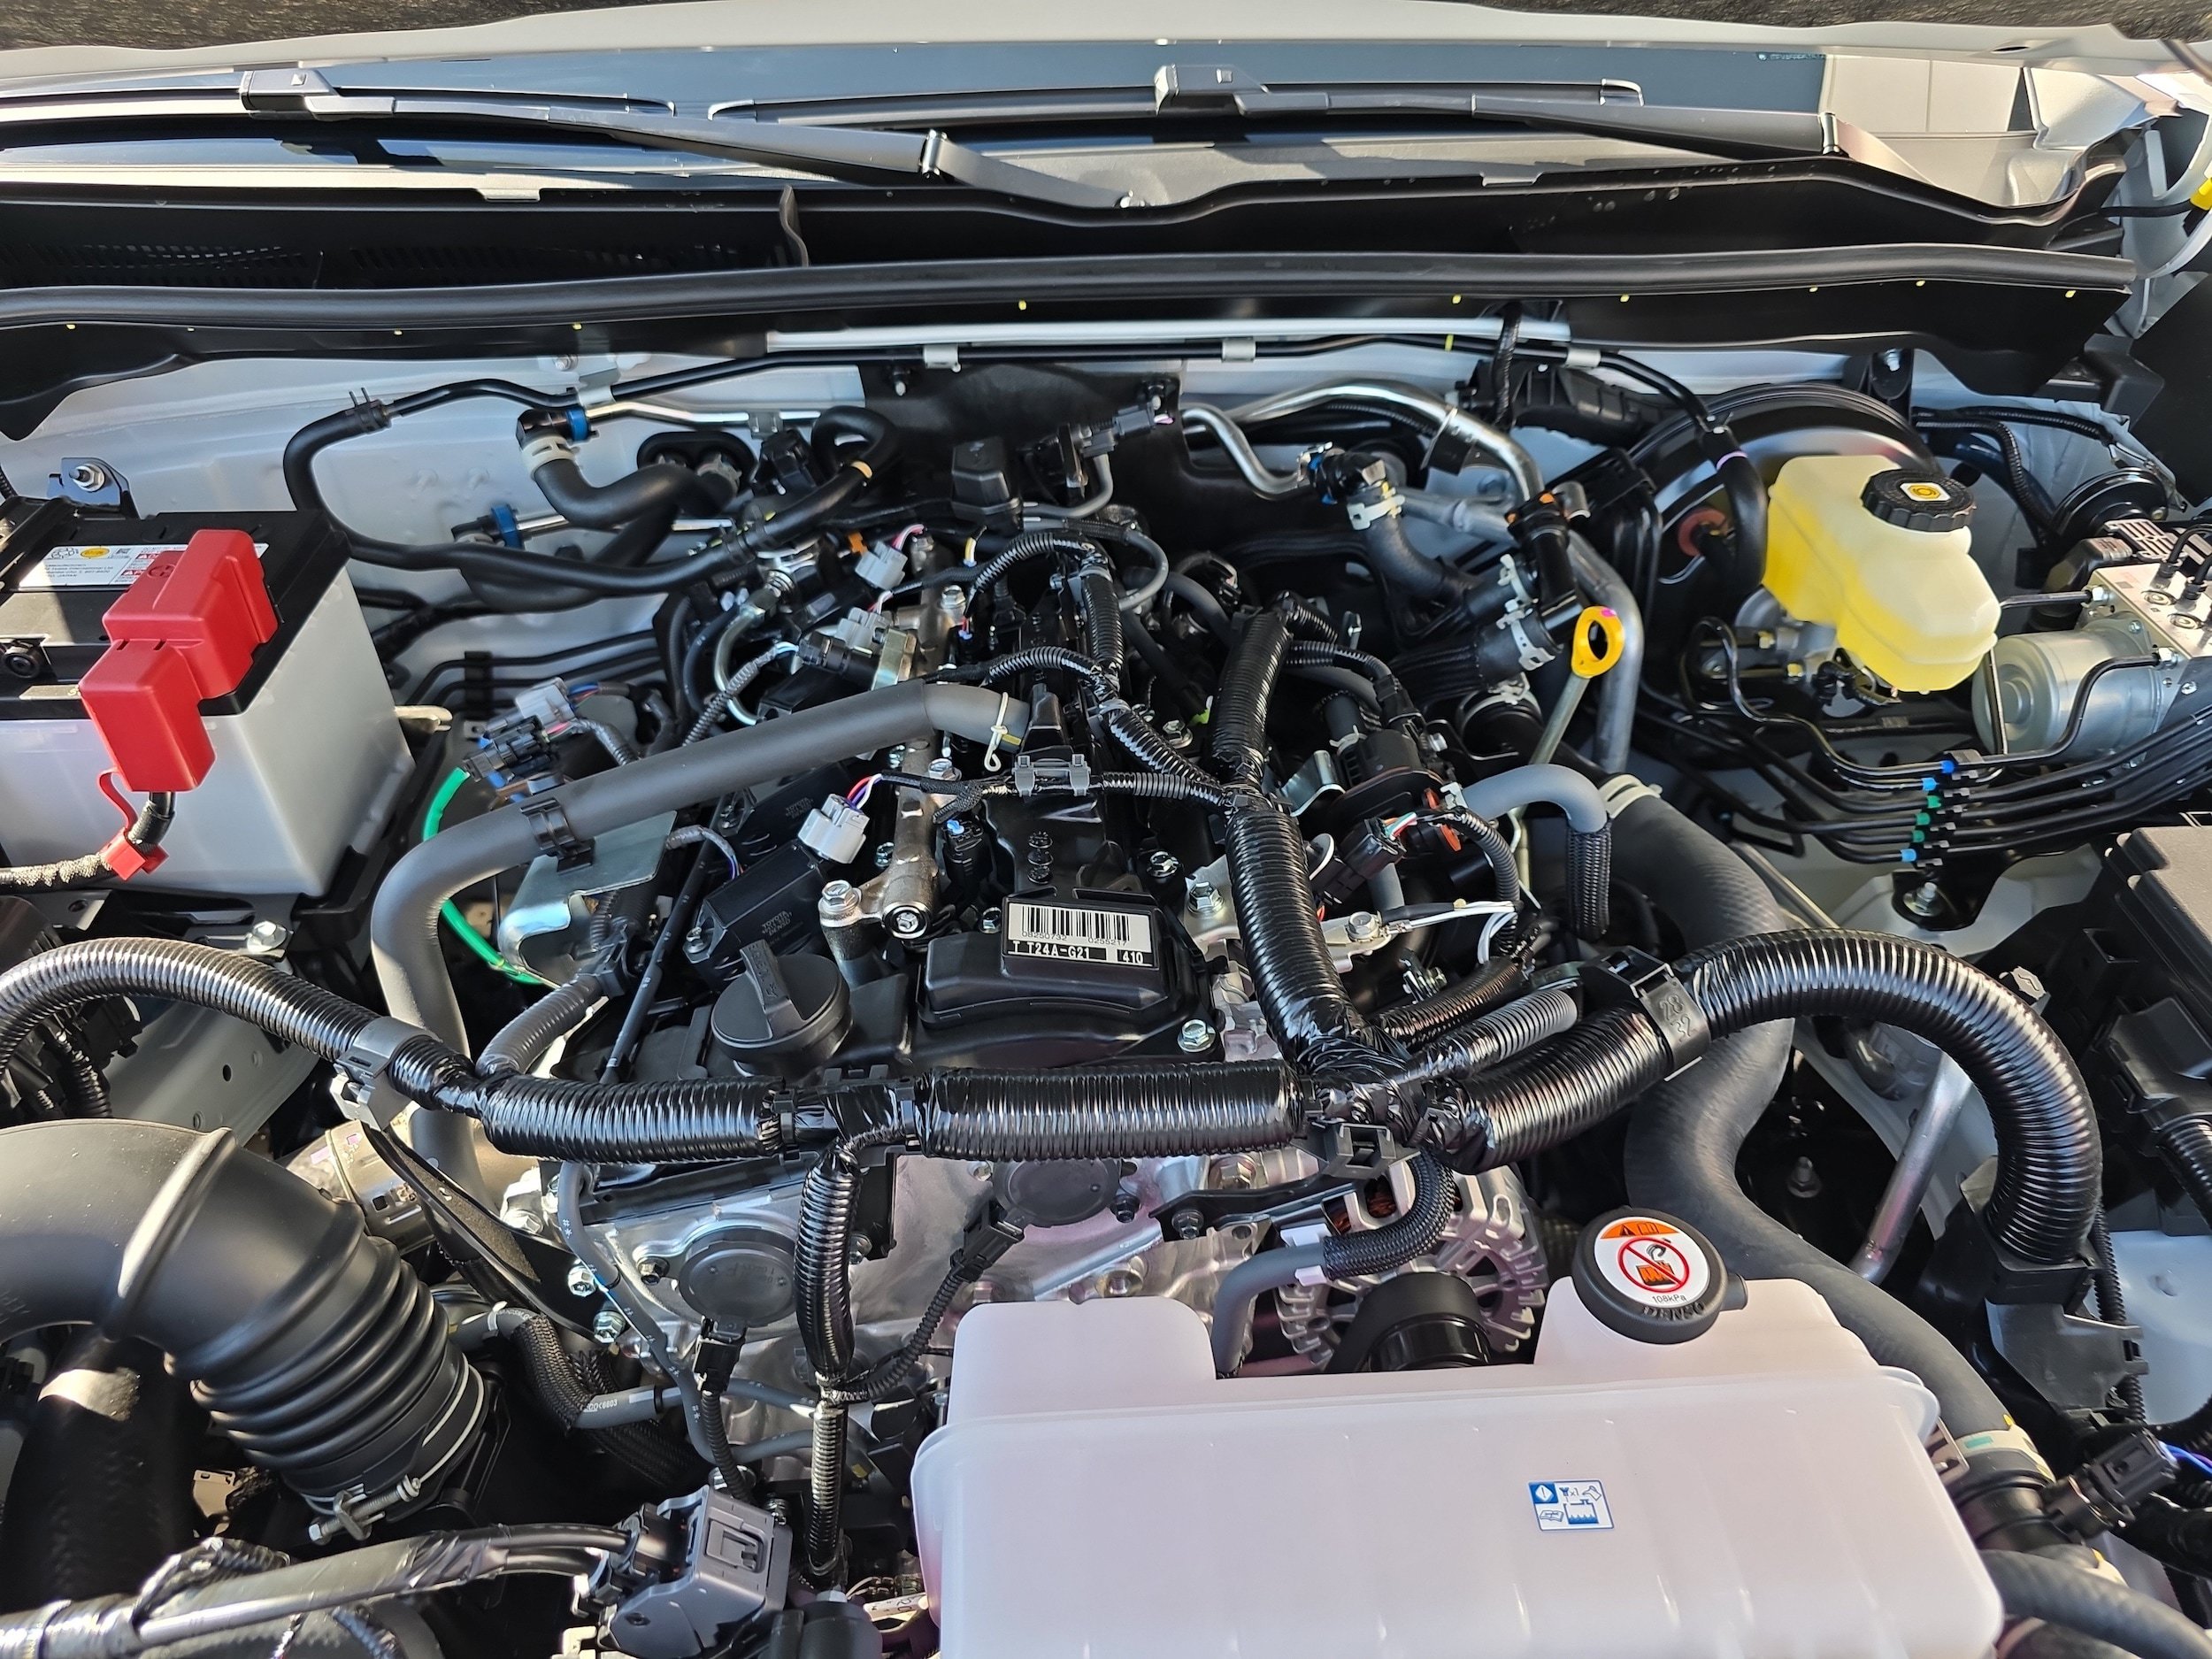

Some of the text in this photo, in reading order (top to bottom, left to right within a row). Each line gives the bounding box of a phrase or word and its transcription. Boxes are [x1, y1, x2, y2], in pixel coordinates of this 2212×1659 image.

[1012, 941, 1144, 964] T T24A-G21 410
[1659, 994, 1684, 1026] 28
[1675, 1013, 1694, 1042] 32
[1651, 1294, 1687, 1304] 108kPa
[1642, 1301, 1706, 1321] DENSO
